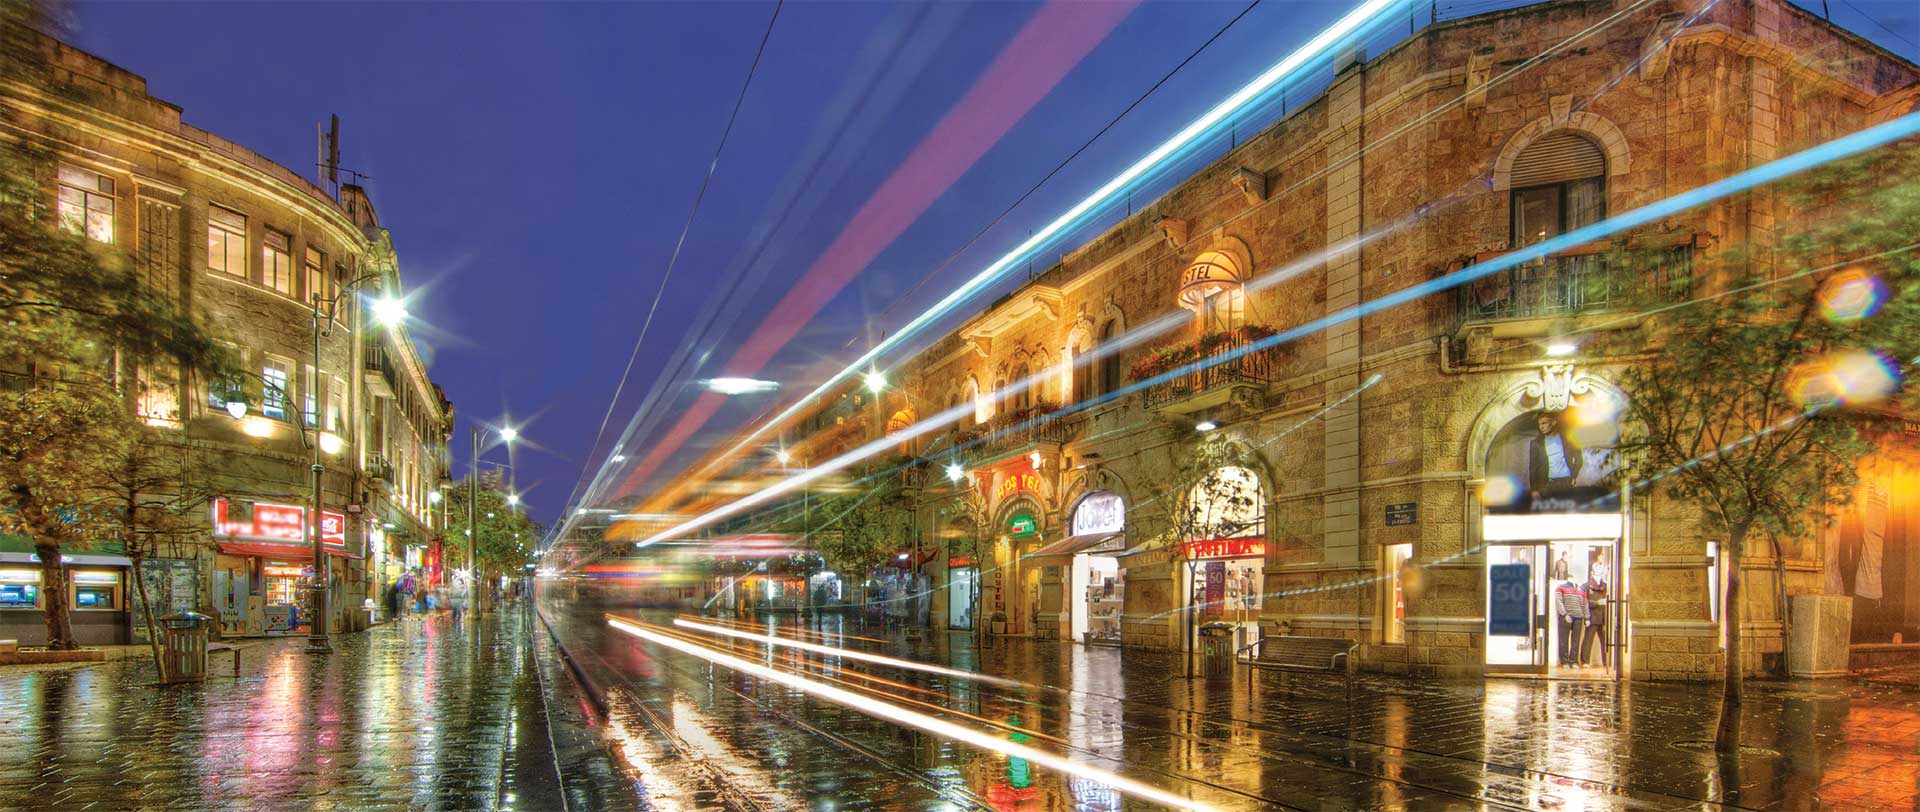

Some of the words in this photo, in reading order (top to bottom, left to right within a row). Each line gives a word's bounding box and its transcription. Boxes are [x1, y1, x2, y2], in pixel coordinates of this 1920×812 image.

[1183, 265, 1211, 285] STEL
[997, 473, 1040, 498] HOSTEL
[1210, 571, 1223, 584] 50
[1495, 583, 1526, 601] 50
